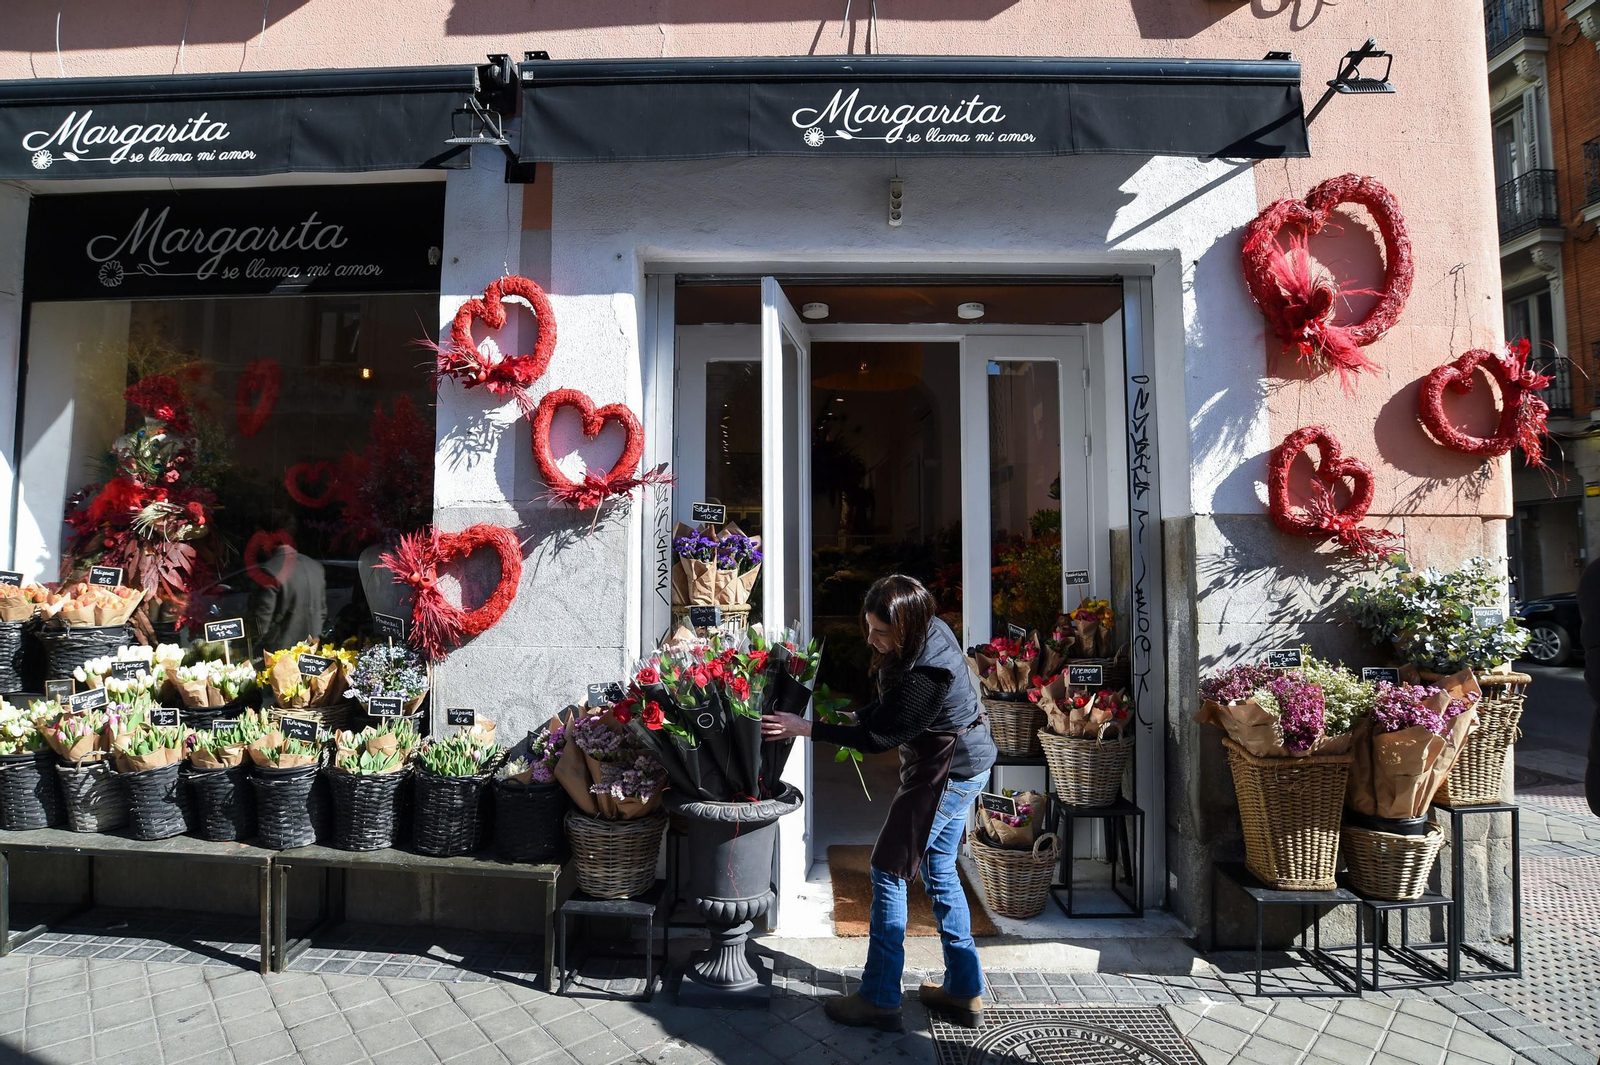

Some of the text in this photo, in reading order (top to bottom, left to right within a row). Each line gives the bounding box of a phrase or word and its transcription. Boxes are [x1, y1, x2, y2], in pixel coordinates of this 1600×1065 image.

[791, 88, 1006, 144] Margarita
[905, 127, 1037, 143] se llama mi amor
[22, 109, 230, 164] Margarita
[128, 146, 257, 163] se llama mi amor
[86, 206, 348, 280] Margarita
[221, 258, 383, 279] se llama mi amor
